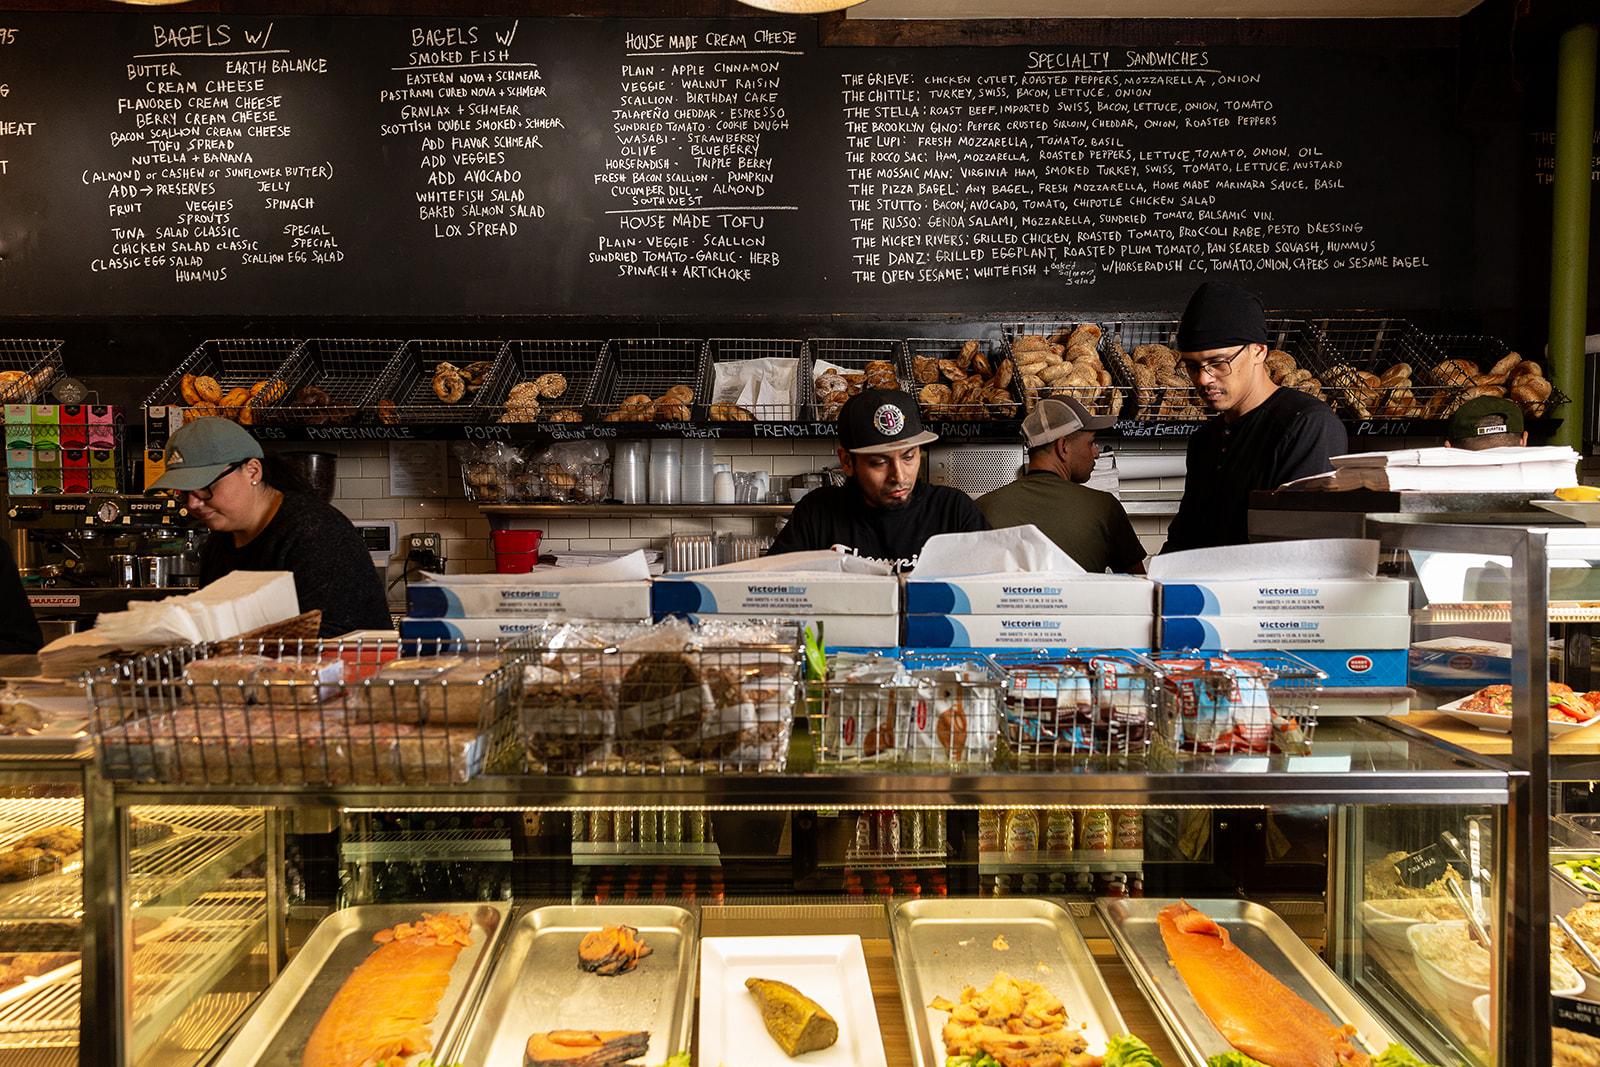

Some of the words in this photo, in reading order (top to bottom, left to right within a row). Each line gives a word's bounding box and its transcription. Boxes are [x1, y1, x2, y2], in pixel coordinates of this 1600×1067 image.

[154, 25, 230, 47] BAGELS
[412, 27, 478, 46] BAGELS
[626, 32, 664, 49] HOUSE
[669, 35, 698, 50] MADE
[706, 33, 746, 48] CREAM
[754, 30, 796, 44] CHEESE
[410, 51, 462, 65] SMOKED
[471, 50, 509, 63] FISH
[1028, 52, 1108, 69] SPECIALTY
[1127, 51, 1208, 67] SANDWICHES
[127, 63, 181, 80] BUTTER
[226, 60, 266, 74] EARTH
[272, 58, 327, 73] BALANCE
[622, 65, 653, 76] PLAIN
[672, 64, 704, 76] APPLE
[714, 62, 779, 73] CINNAMON
[146, 82, 197, 94] CREAM
[206, 79, 264, 93] CHEESE
[621, 81, 665, 92] VEGGIE
[682, 79, 727, 89] WALNUT
[736, 77, 779, 89] RAISIN
[118, 98, 181, 113] FLAVORED
[188, 98, 228, 108] CREAM
[236, 96, 282, 109] CHEESE
[845, 122, 868, 133] THE
[872, 122, 924, 132] BROOKLYN
[968, 121, 1001, 131] PEPPER
[1007, 121, 1048, 130] CRUSTED
[1185, 117, 1229, 127] ROASTED
[1238, 116, 1276, 126] PEPPERS
[111, 132, 144, 147] BACON
[206, 127, 241, 137] CREAM
[248, 126, 290, 137] CHEESE
[422, 137, 444, 151] ADD
[452, 137, 489, 150] FLAVOR
[494, 135, 543, 148] SCHMEAR
[847, 136, 872, 147] THE
[919, 137, 952, 146] FRESH
[1091, 138, 1123, 146] BASIL
[421, 155, 446, 168] ADD
[453, 152, 504, 165] VEGGIES
[428, 171, 455, 185] ADD
[464, 170, 521, 183] AVOCADO
[109, 185, 137, 198] ADD
[157, 182, 215, 195] PRESERVES
[257, 181, 290, 192] JELLY
[416, 190, 483, 203] WHITEFISH
[491, 189, 524, 202] SALAD
[110, 203, 141, 216] FRUIT
[186, 199, 233, 212] VEGGIES
[265, 198, 314, 210] SPINACH
[420, 205, 454, 220] BAKED
[462, 204, 503, 216] SALMON
[510, 204, 545, 217] SALAD
[435, 224, 461, 237] LOX
[468, 221, 517, 236] SPREAD
[621, 215, 665, 229] HOUSE
[673, 214, 710, 228] MADE
[717, 214, 764, 229] TOFU
[112, 227, 144, 240] TUNA
[156, 227, 188, 239] SALAD
[194, 226, 240, 237] CLASSIC
[283, 224, 330, 236] SPECIAL
[92, 257, 140, 271] CLASSIC
[144, 255, 165, 266] EGG
[170, 256, 202, 266] SALAD
[288, 251, 307, 263] EGG
[312, 250, 344, 264] SALAD
[176, 268, 227, 282] HUMMUS
[852, 271, 876, 282] THE
[882, 270, 914, 284] OPEN
[974, 265, 1036, 278] WHITEFISH
[1293, 258, 1328, 270] CAPERS
[1349, 256, 1388, 268] SESAME
[1393, 257, 1428, 268] BAGEL
[537, 423, 566, 432] MULTI
[656, 422, 697, 431] WHOLE
[885, 411, 896, 429] B
[1112, 421, 1145, 430] WHOLE
[306, 426, 415, 440] PUMPERNICKLE
[464, 425, 512, 440] POPPY
[552, 430, 586, 440] GRAIN
[593, 427, 618, 438] OATS
[682, 427, 722, 439] WHEAT
[753, 423, 810, 437] FRENCH
[941, 422, 982, 437] RAISIN
[1122, 427, 1153, 437] WHEAT
[1357, 421, 1411, 436] PLAIN
[748, 585, 787, 593] Victoria
[1259, 587, 1299, 595] Victoria
